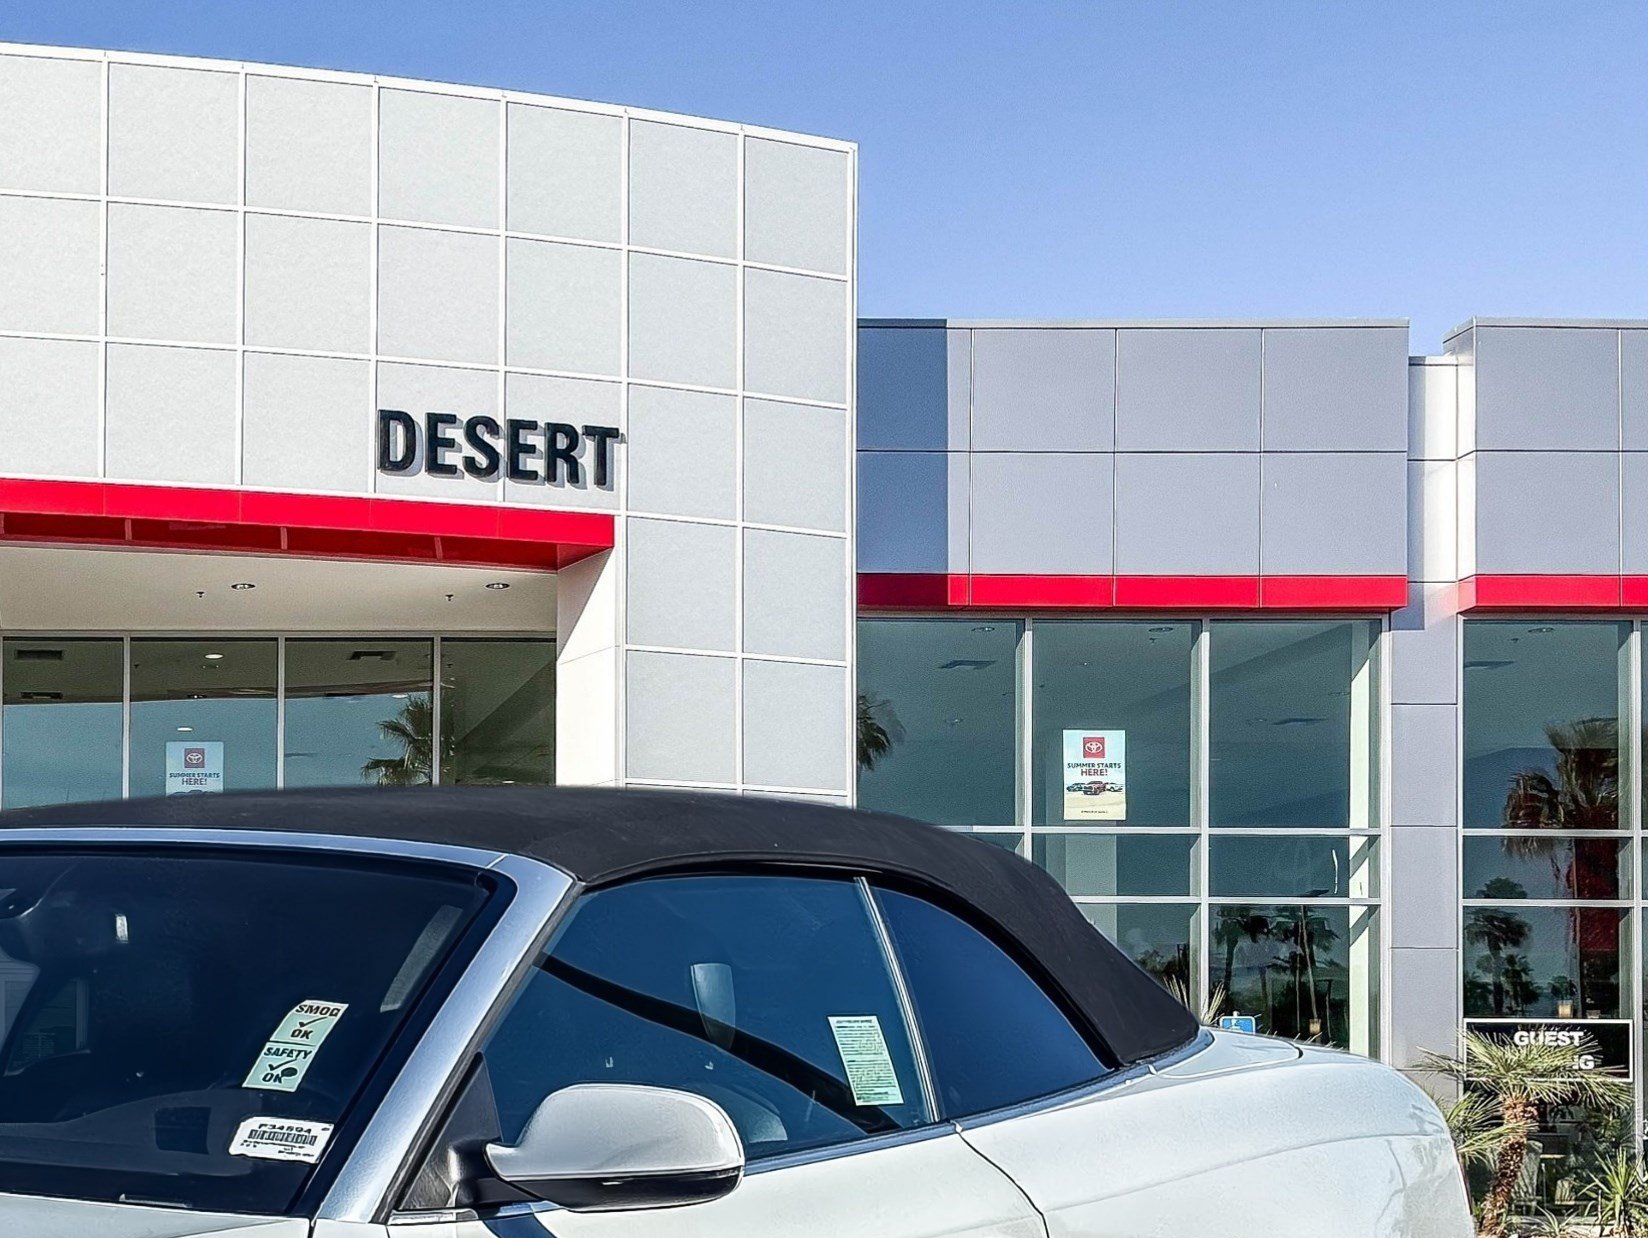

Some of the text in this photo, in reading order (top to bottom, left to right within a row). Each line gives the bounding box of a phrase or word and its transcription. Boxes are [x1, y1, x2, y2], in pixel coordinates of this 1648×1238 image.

[377, 409, 620, 487] DESERT
[1080, 768, 1108, 776] HERE!
[181, 778, 208, 786] HERE!
[295, 1004, 342, 1018] SMOG
[290, 1028, 314, 1040] OK
[1513, 1030, 1585, 1047] GUEST
[263, 1046, 312, 1060] SAFETY
